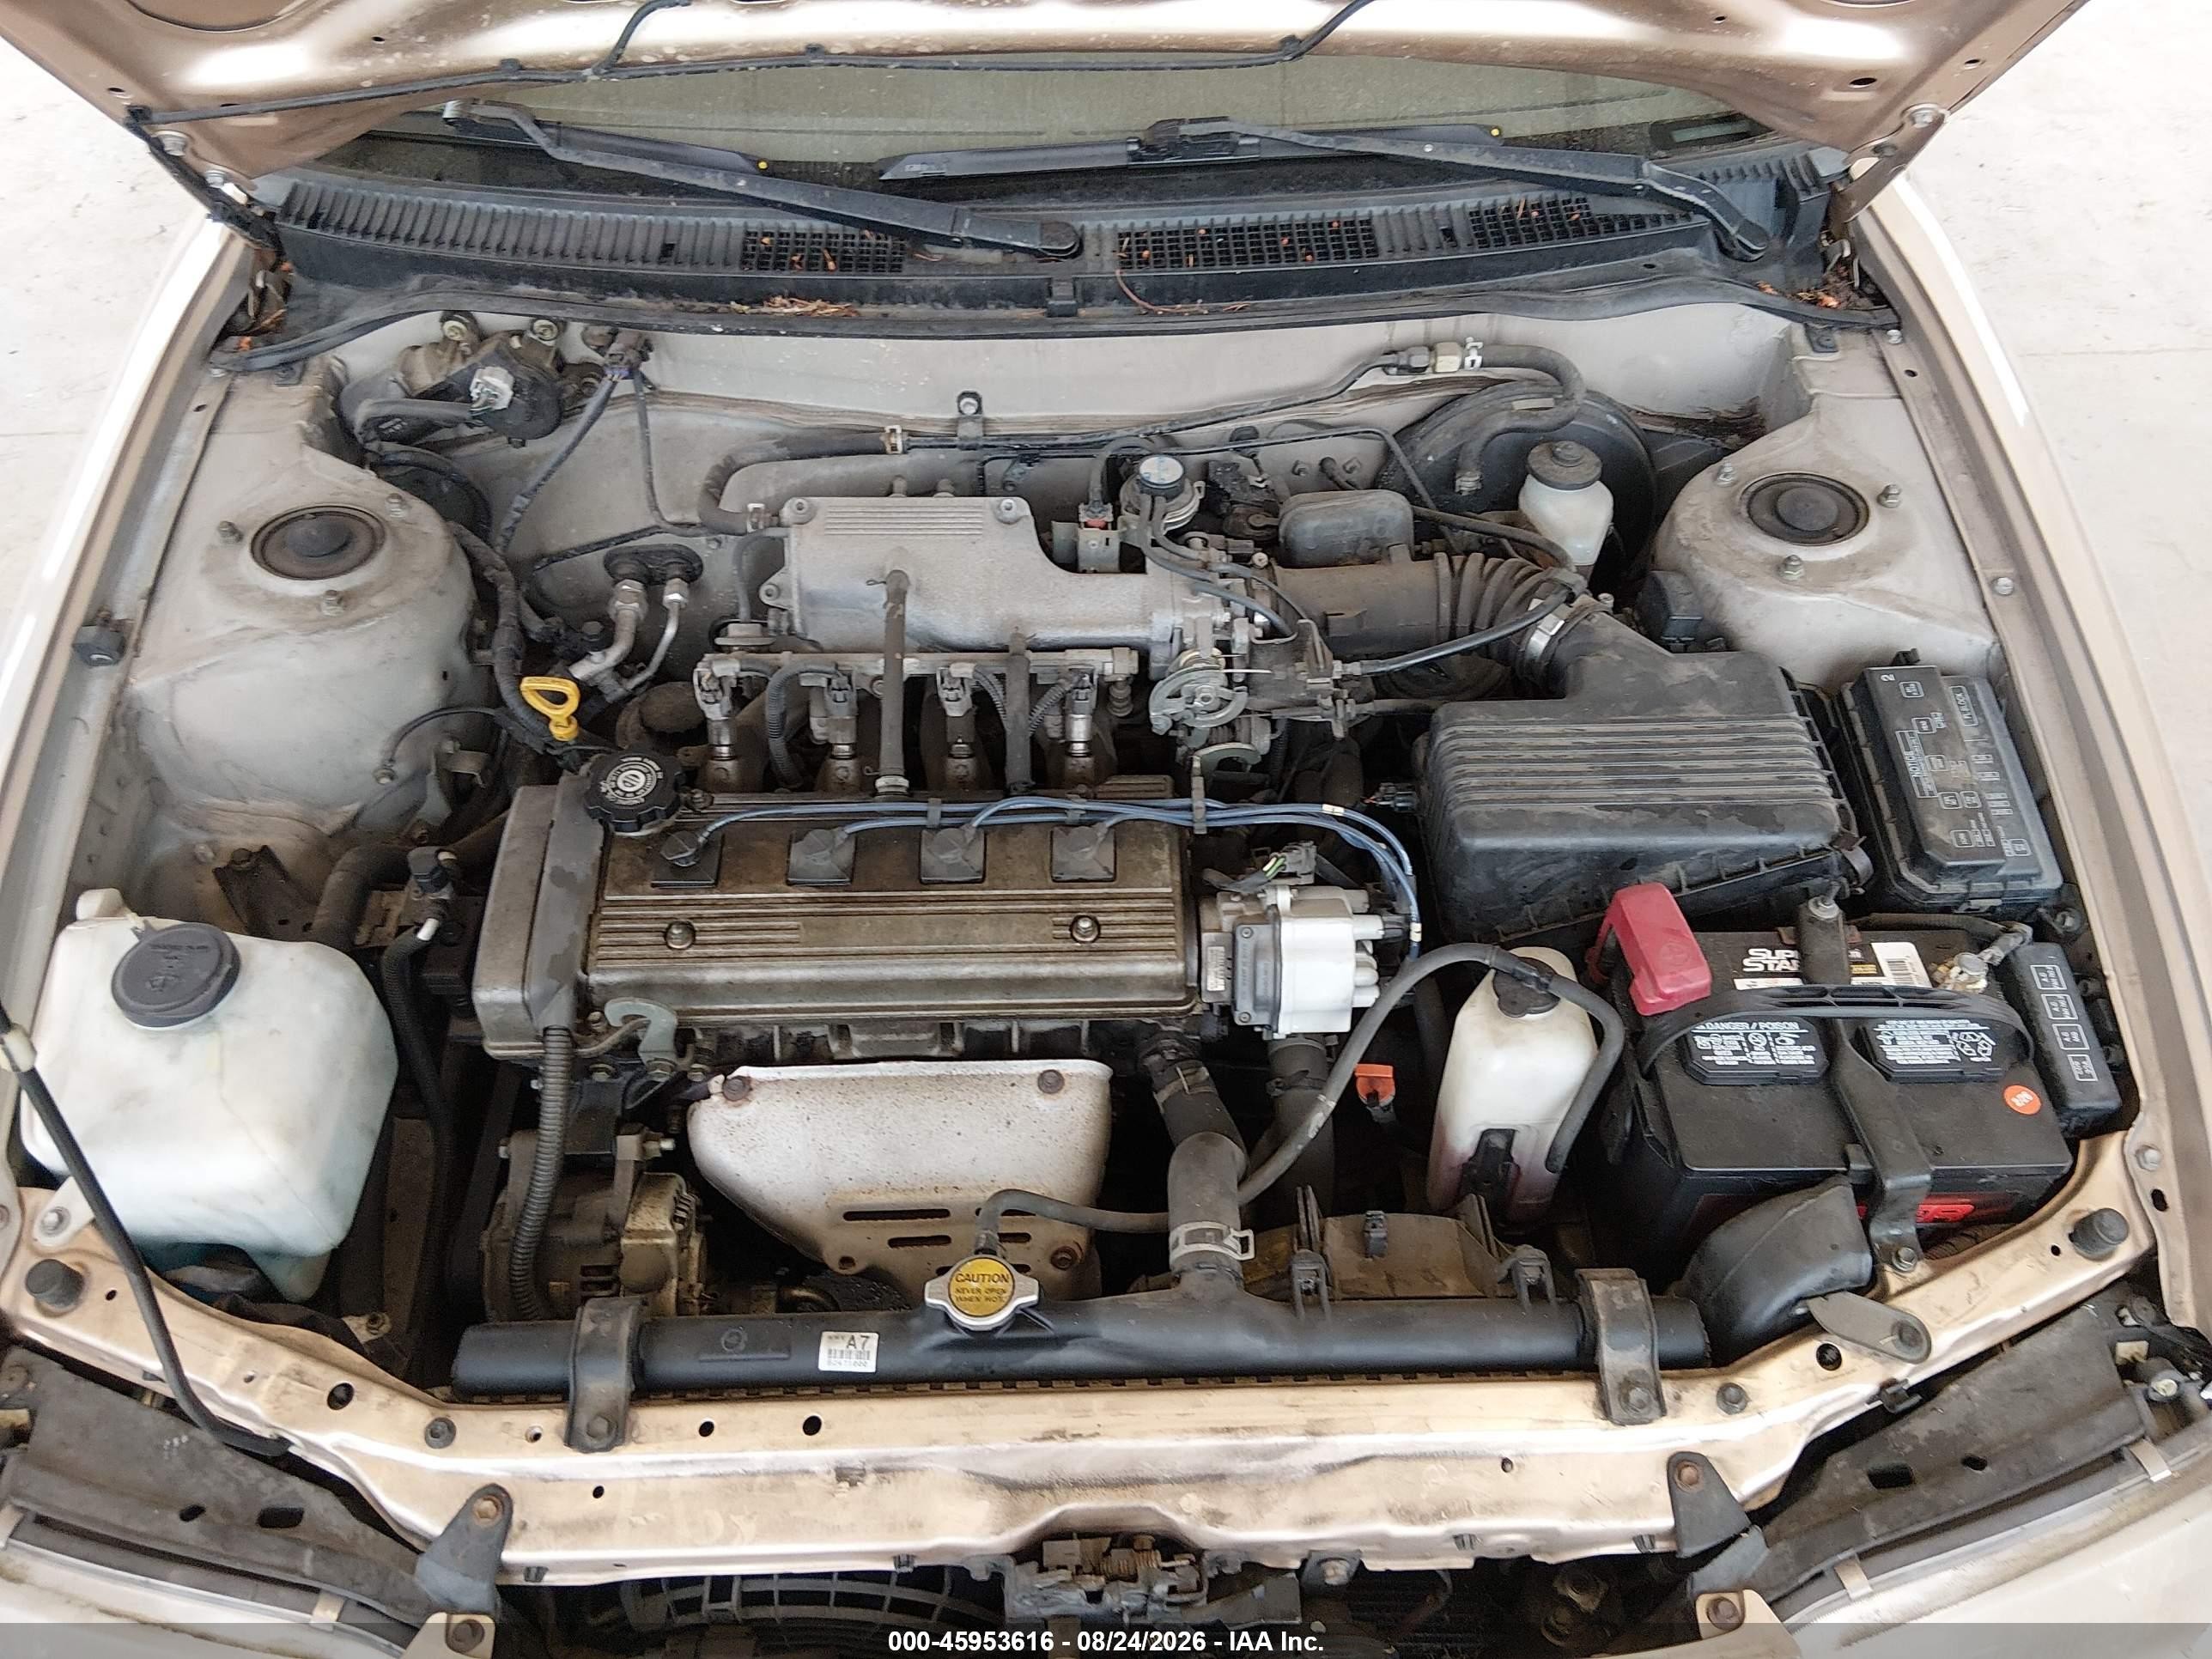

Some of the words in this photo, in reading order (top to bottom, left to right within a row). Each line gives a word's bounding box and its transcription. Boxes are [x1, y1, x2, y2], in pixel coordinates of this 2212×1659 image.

[1905, 750, 1922, 778] NOTICE
[1758, 1022, 1800, 1030] POISON
[955, 1273, 1009, 1284] CAUTION
